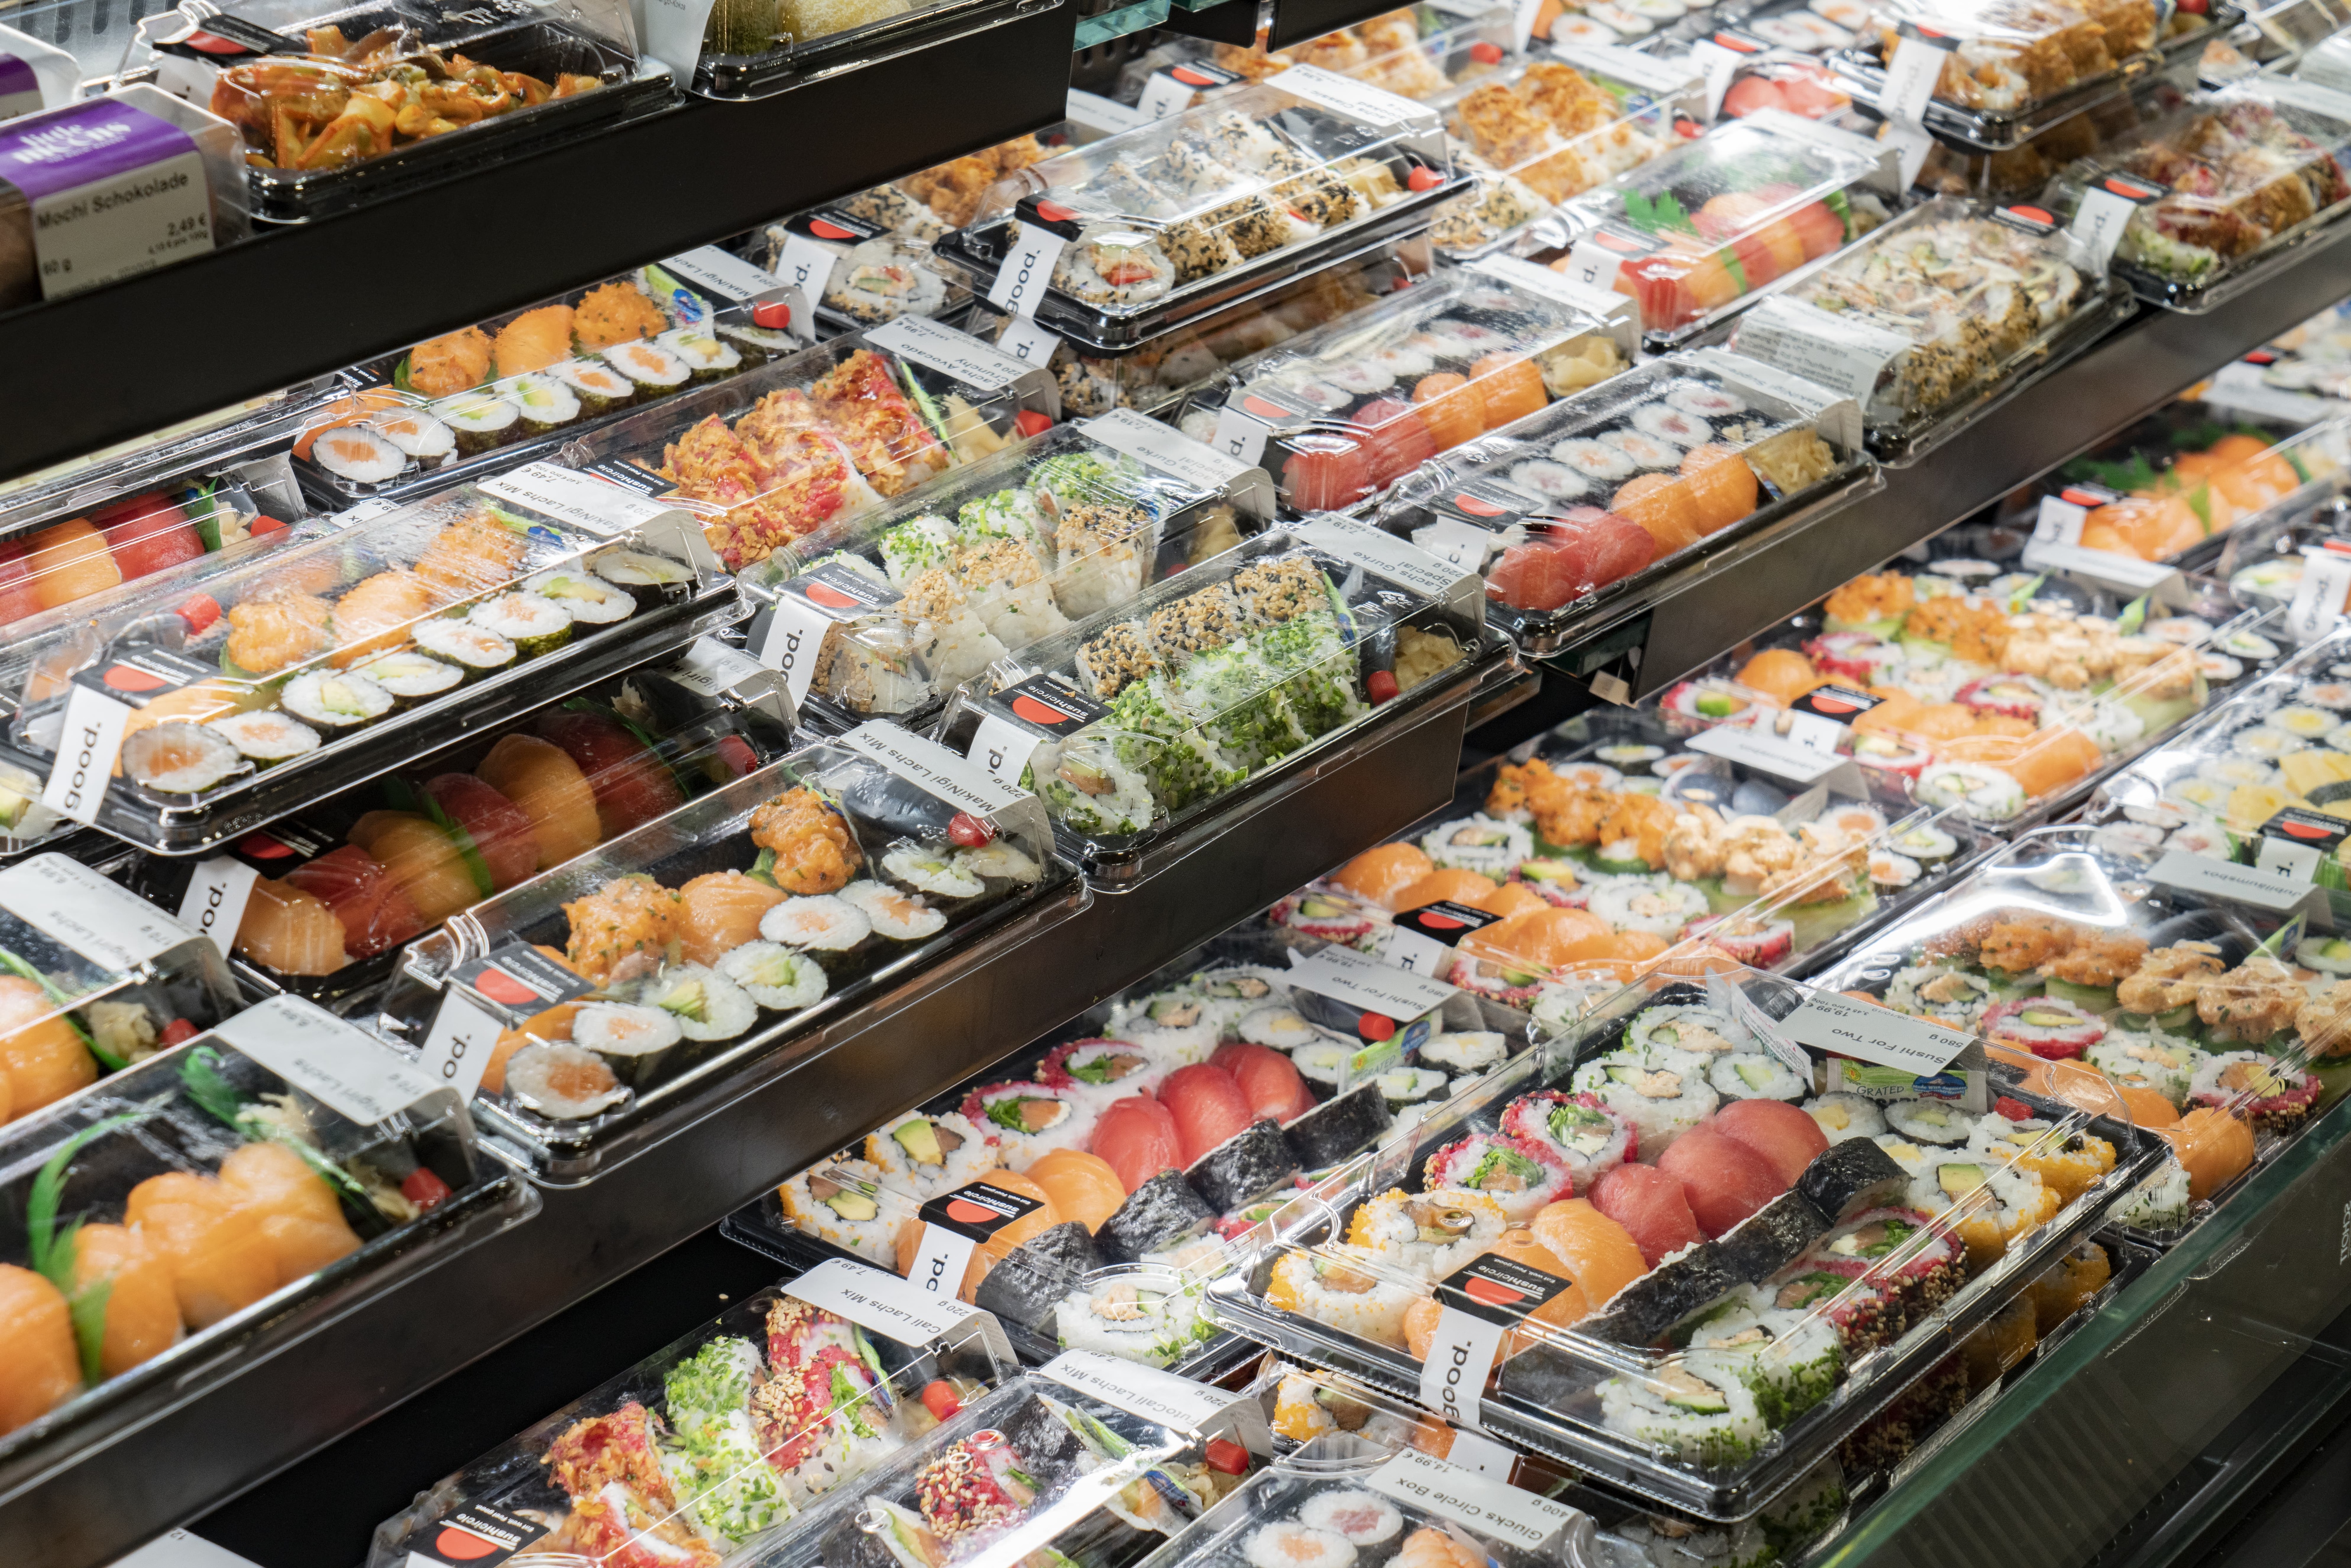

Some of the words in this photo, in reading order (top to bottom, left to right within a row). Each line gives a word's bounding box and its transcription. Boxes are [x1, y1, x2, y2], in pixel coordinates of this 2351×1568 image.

[36, 202, 87, 229] Mochi
[93, 171, 188, 213] Schokolade
[167, 216, 195, 236] 2,49
[198, 212, 207, 228] €
[702, 273, 752, 297] MakiNigi
[1006, 250, 1041, 315] good.
[904, 325, 927, 338] 7,99
[901, 343, 958, 370] Avocado
[955, 358, 1009, 383] Crunchy
[1001, 367, 1023, 377] 220
[961, 370, 999, 388] Lachs
[1255, 389, 1309, 414] sushicircle
[1120, 418, 1144, 431] 7,19
[1136, 446, 1176, 466] Gurke
[614, 460, 631, 469] good.
[630, 467, 642, 476] Feel
[1178, 457, 1231, 480] Special
[531, 471, 558, 483] 7,49
[597, 464, 653, 492] sushicircle
[654, 477, 665, 486] Eat
[495, 481, 522, 493] Mix
[586, 479, 620, 492] 08/10/19
[523, 491, 564, 511] Lachs
[565, 506, 626, 532] MakiNigi
[635, 507, 657, 518] 220
[1333, 521, 1356, 535] 7,19
[1353, 551, 1396, 572] Gurke
[836, 568, 852, 578] good.
[1397, 561, 1452, 586] Special
[1442, 567, 1465, 578] 220
[821, 572, 880, 602] sushicircle
[852, 576, 867, 585] Feel
[866, 582, 882, 591] well.
[1399, 570, 1444, 592] Lachs
[729, 665, 752, 677] 170
[681, 670, 726, 692] Nigiri
[1044, 680, 1063, 691] good.
[1028, 685, 1089, 717] sushicircle
[1074, 695, 1091, 706] well.
[859, 732, 887, 751] Mix
[64, 721, 103, 811] good.
[887, 749, 933, 777] Lachs
[931, 776, 997, 813] MakiNigi
[1001, 784, 1026, 799] 220
[500, 956, 564, 995] sushicircle
[1332, 976, 1359, 990] Two
[1363, 987, 1387, 998] For
[1387, 994, 1427, 1011] Sushi
[1811, 997, 1834, 1008] 100g
[1815, 1004, 1849, 1017] 19,99
[1871, 1008, 1910, 1021] 08/10/19
[1831, 1028, 1863, 1043] Two
[1939, 1037, 1964, 1048] 580
[1867, 1039, 1898, 1052] For
[443, 1034, 472, 1079] od.
[1901, 1046, 1947, 1064] Sushi
[1856, 1085, 1905, 1097] GRATED
[979, 1185, 995, 1193] good.
[963, 1190, 1019, 1213] sushicircle
[840, 1262, 868, 1276] 7,49
[1493, 1258, 1515, 1269] good.
[1512, 1264, 1528, 1274] Feel
[926, 1253, 949, 1292] od.
[1478, 1265, 1546, 1293] sushicircle
[1527, 1269, 1548, 1280] well.
[1544, 1276, 1556, 1284] Eat
[840, 1288, 868, 1304] Mix
[868, 1300, 913, 1322] Lachs
[946, 1305, 970, 1317] 220
[914, 1320, 941, 1334] Cali
[1060, 1363, 1089, 1380] Mix
[1443, 1340, 1473, 1419] good.
[1089, 1376, 1134, 1400] Lachs
[1203, 1395, 1229, 1407] 220
[1135, 1395, 1202, 1426] FutoCali
[1402, 1450, 1414, 1459] €
[1414, 1458, 1451, 1473] 14,99
[1394, 1477, 1431, 1496] Box
[474, 1504, 495, 1515] good.
[1432, 1491, 1482, 1516] Circle
[491, 1512, 508, 1522] Feel
[1541, 1504, 1569, 1519] 400
[457, 1513, 521, 1543] sushicircle
[521, 1524, 535, 1533] Eat
[1484, 1511, 1544, 1541] Glücks
